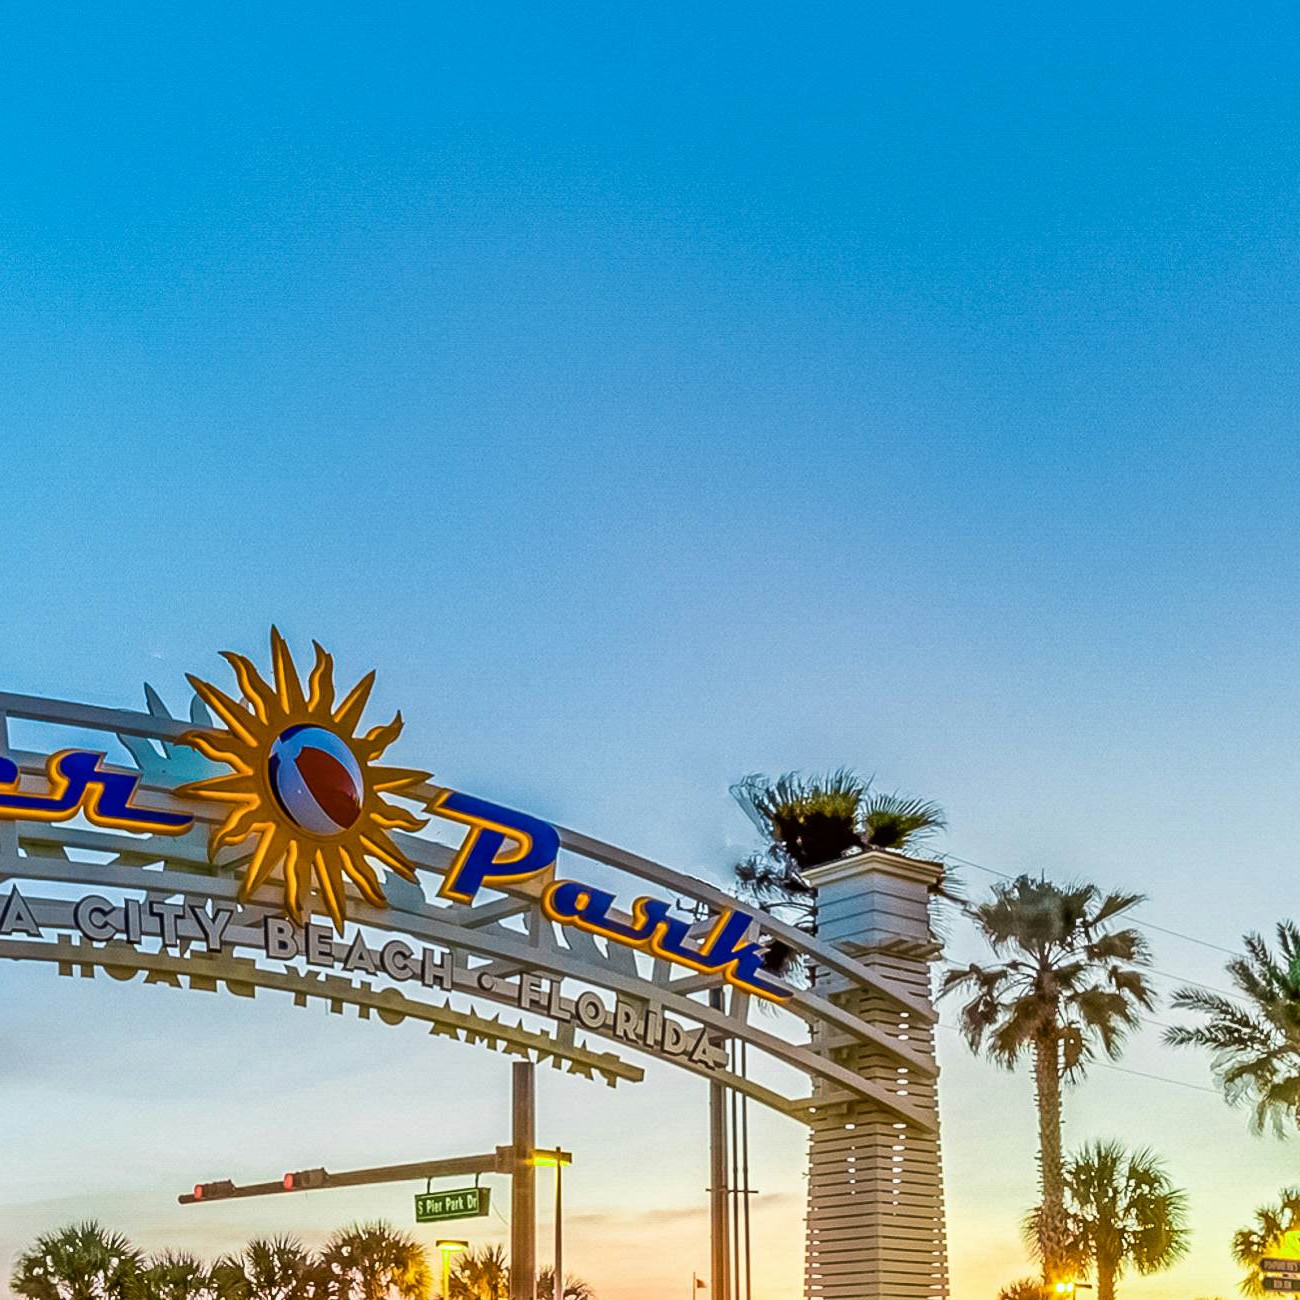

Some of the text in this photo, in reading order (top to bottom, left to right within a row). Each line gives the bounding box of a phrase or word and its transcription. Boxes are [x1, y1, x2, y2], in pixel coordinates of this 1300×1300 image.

[71, 893, 234, 955] CITY
[262, 913, 456, 993] BEACH
[518, 970, 730, 1071] FLORIDA
[425, 787, 797, 1002] Park
[418, 1194, 477, 1215] S Pier Park Dr
